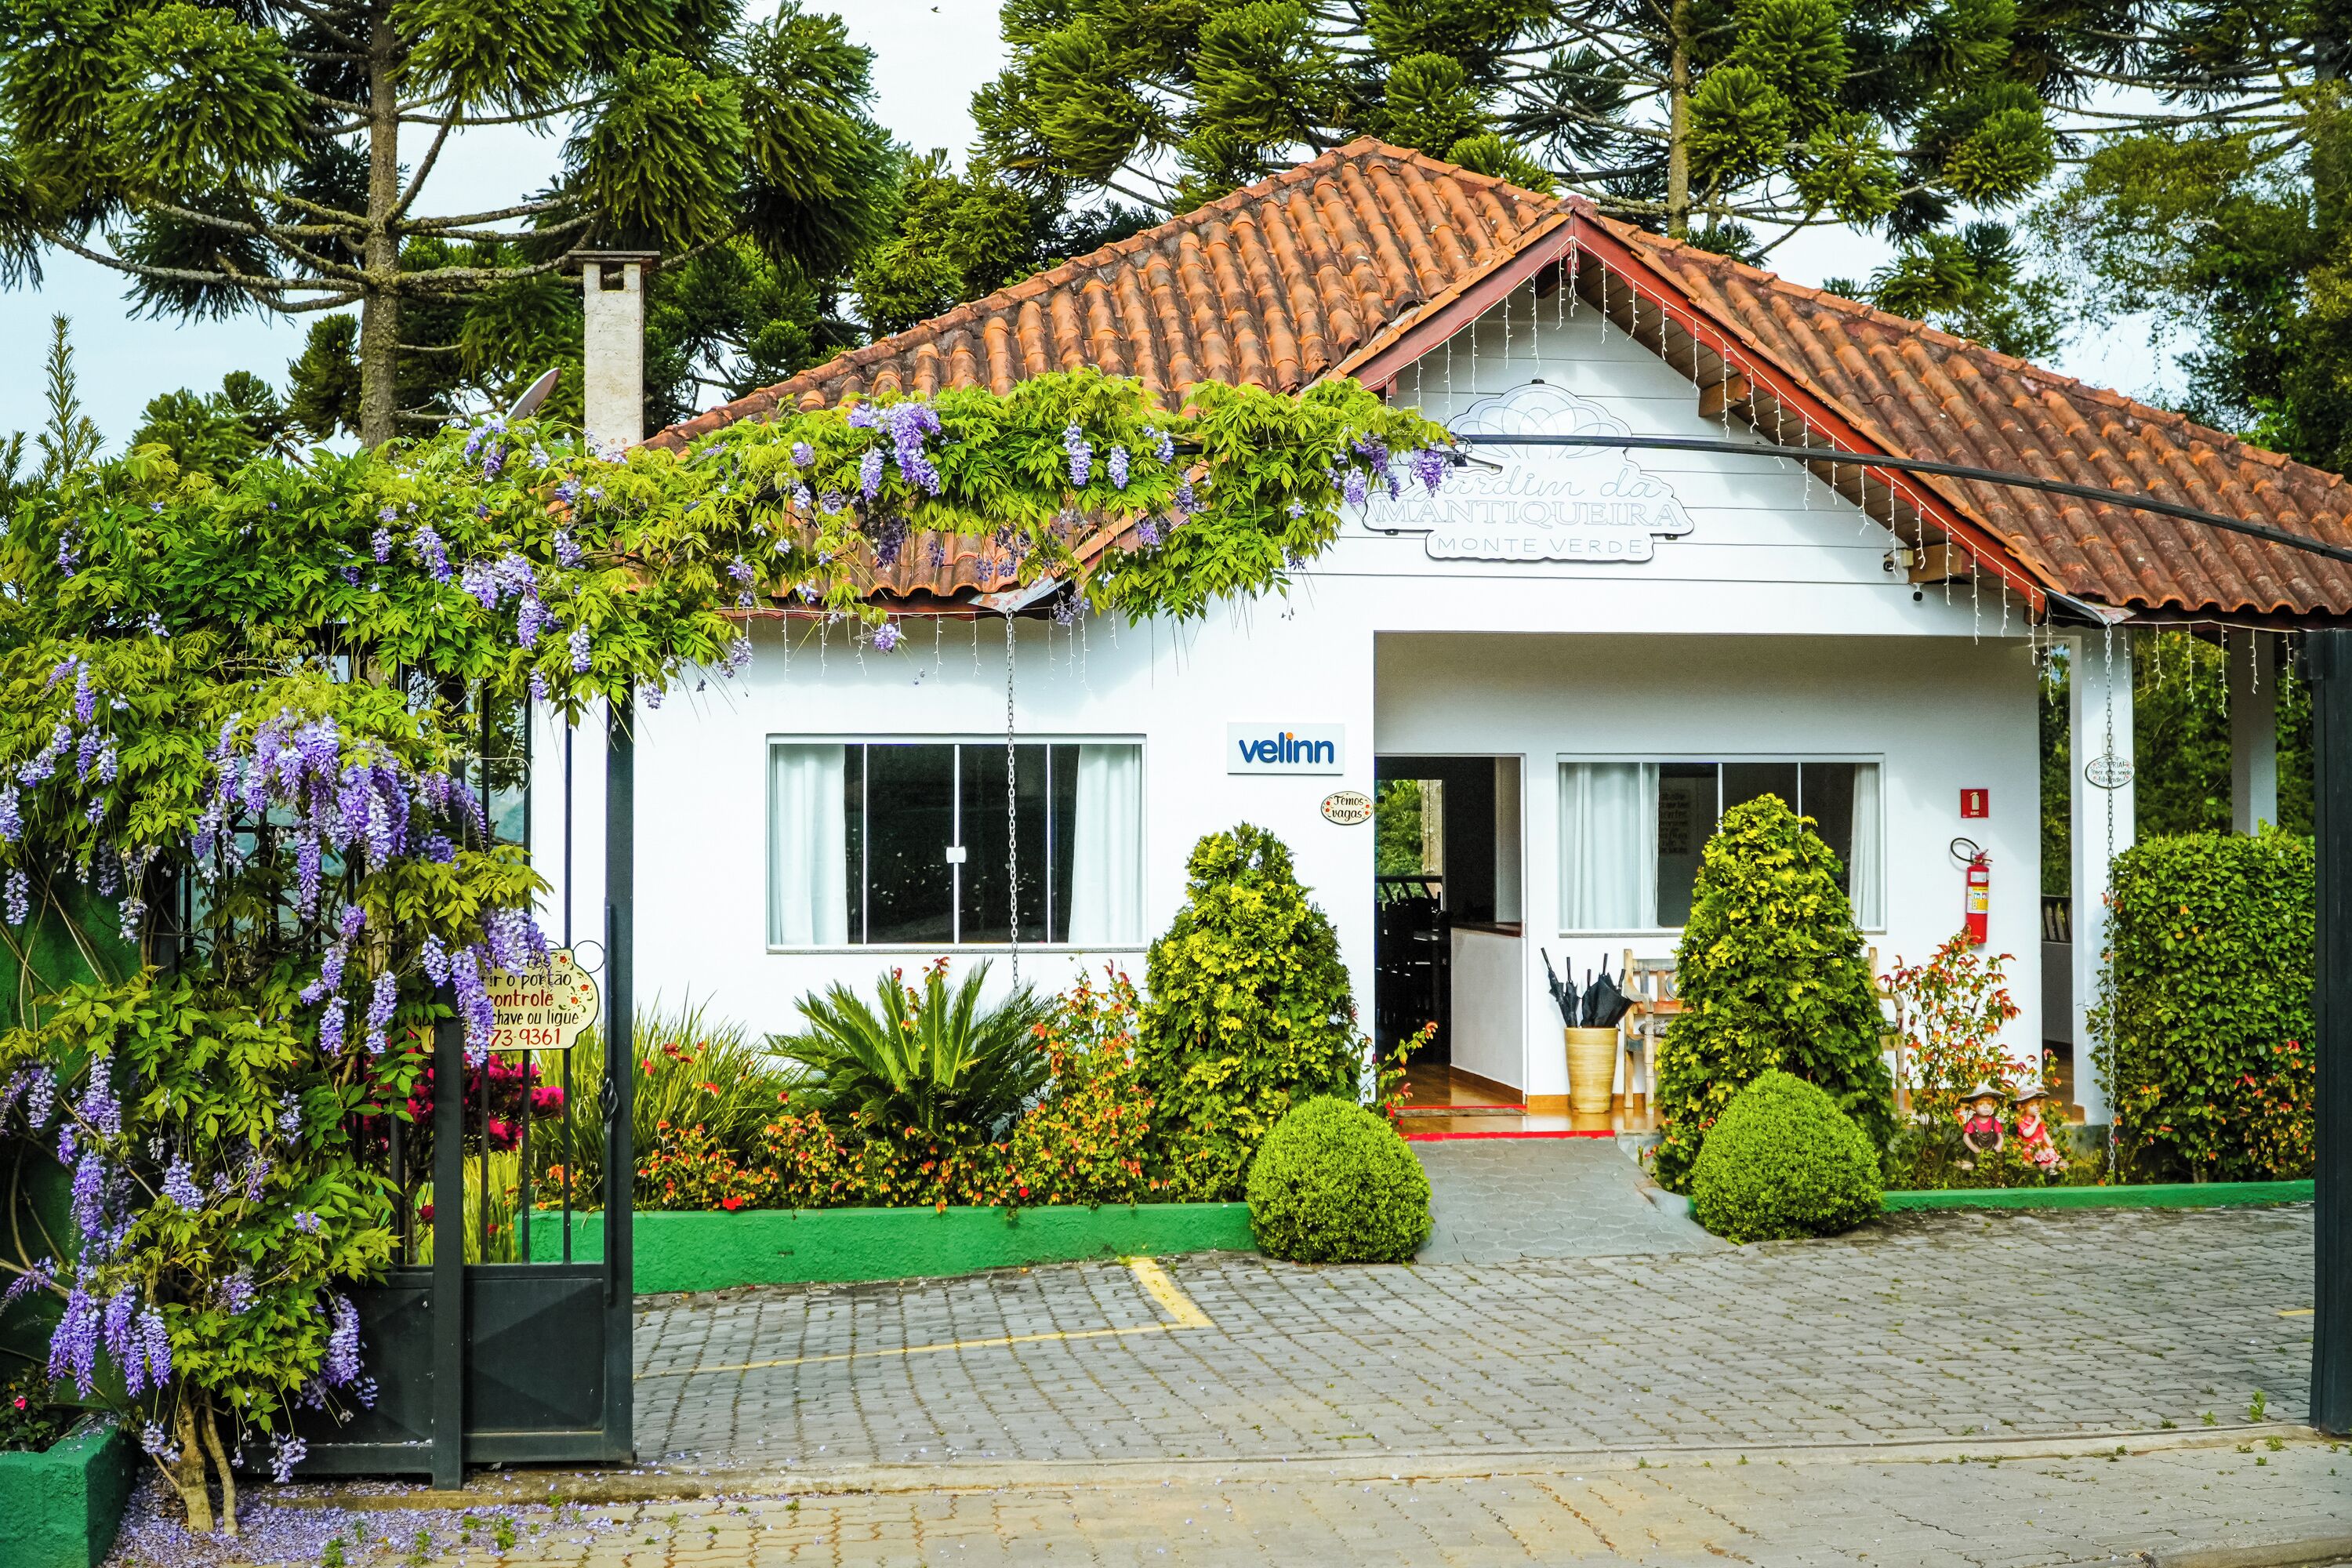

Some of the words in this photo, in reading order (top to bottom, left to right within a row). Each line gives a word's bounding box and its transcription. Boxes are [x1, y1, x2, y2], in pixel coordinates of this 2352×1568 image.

[1600, 467, 1661, 498] da
[1377, 499, 1682, 529] MANTIQUEIRA
[1438, 537, 1537, 553] MONTE
[1549, 539, 1642, 554] VERDE
[1239, 731, 1334, 764] velinn
[1334, 795, 1364, 806] Temos
[1332, 808, 1363, 822] vagas
[506, 975, 515, 987] o
[527, 1012, 542, 1025] ou
[546, 1008, 579, 1027] ligue
[490, 1027, 561, 1047] 73-9361
